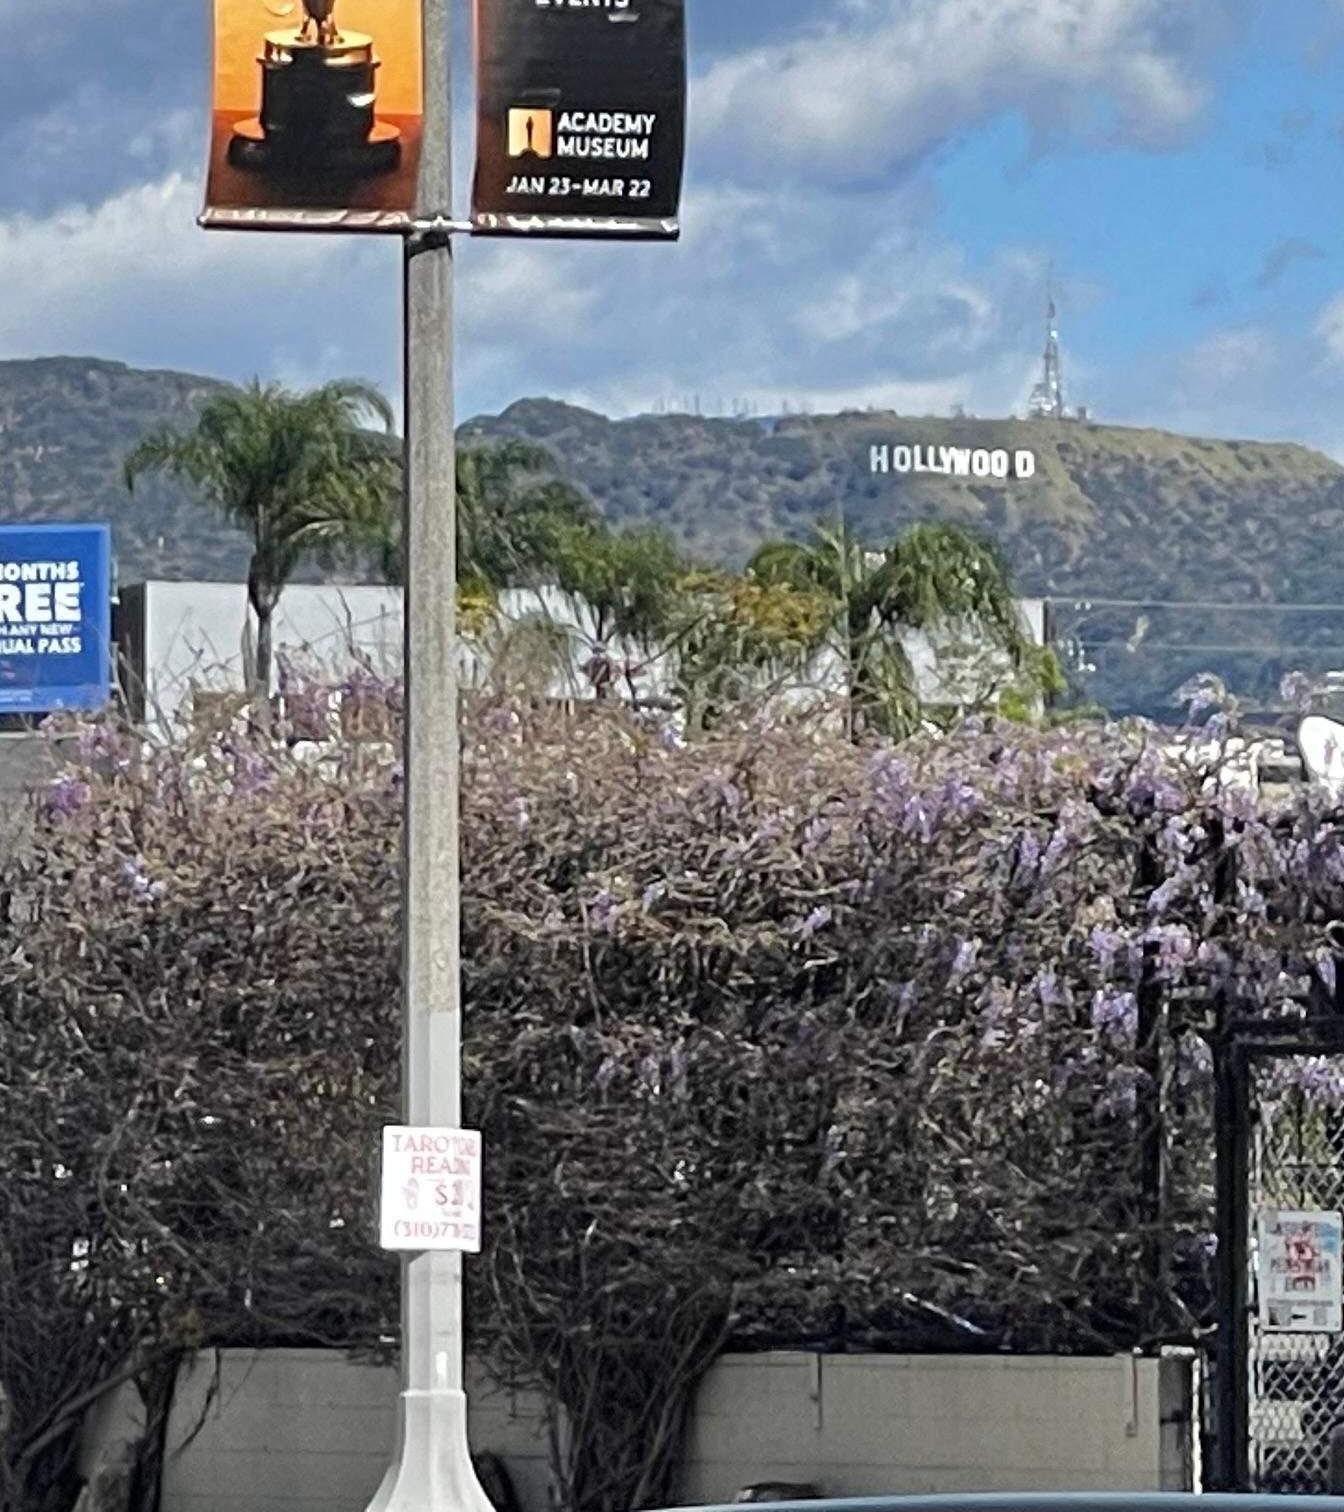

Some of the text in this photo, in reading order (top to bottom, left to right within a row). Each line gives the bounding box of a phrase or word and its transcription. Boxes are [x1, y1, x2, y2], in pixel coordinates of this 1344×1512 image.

[557, 112, 656, 135] ACADEMY
[557, 135, 649, 159] MUSEUM
[506, 176, 544, 194] JAN
[628, 179, 651, 197] 22
[869, 444, 1035, 478] HOLLYWOOD
[37, 637, 82, 654] PASS
